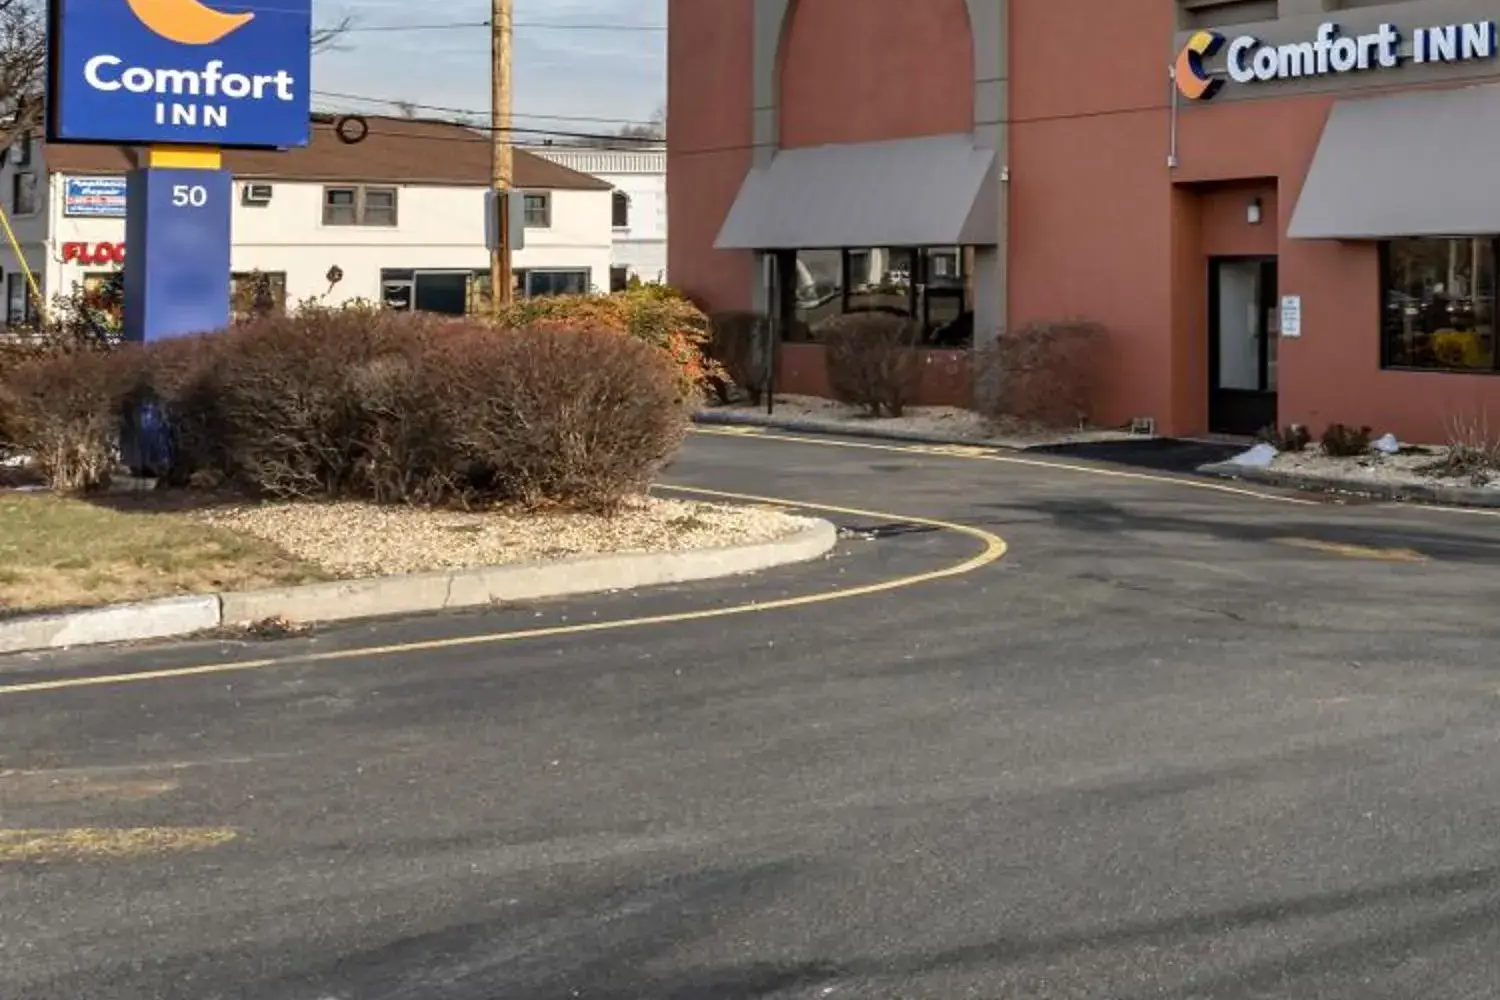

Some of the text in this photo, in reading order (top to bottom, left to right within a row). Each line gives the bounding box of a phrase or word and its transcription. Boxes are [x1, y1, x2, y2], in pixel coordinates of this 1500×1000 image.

[1226, 21, 1497, 83] Comfort INN
[84, 54, 294, 101] Comfort
[155, 102, 228, 127] INN
[172, 185, 207, 207] 50
